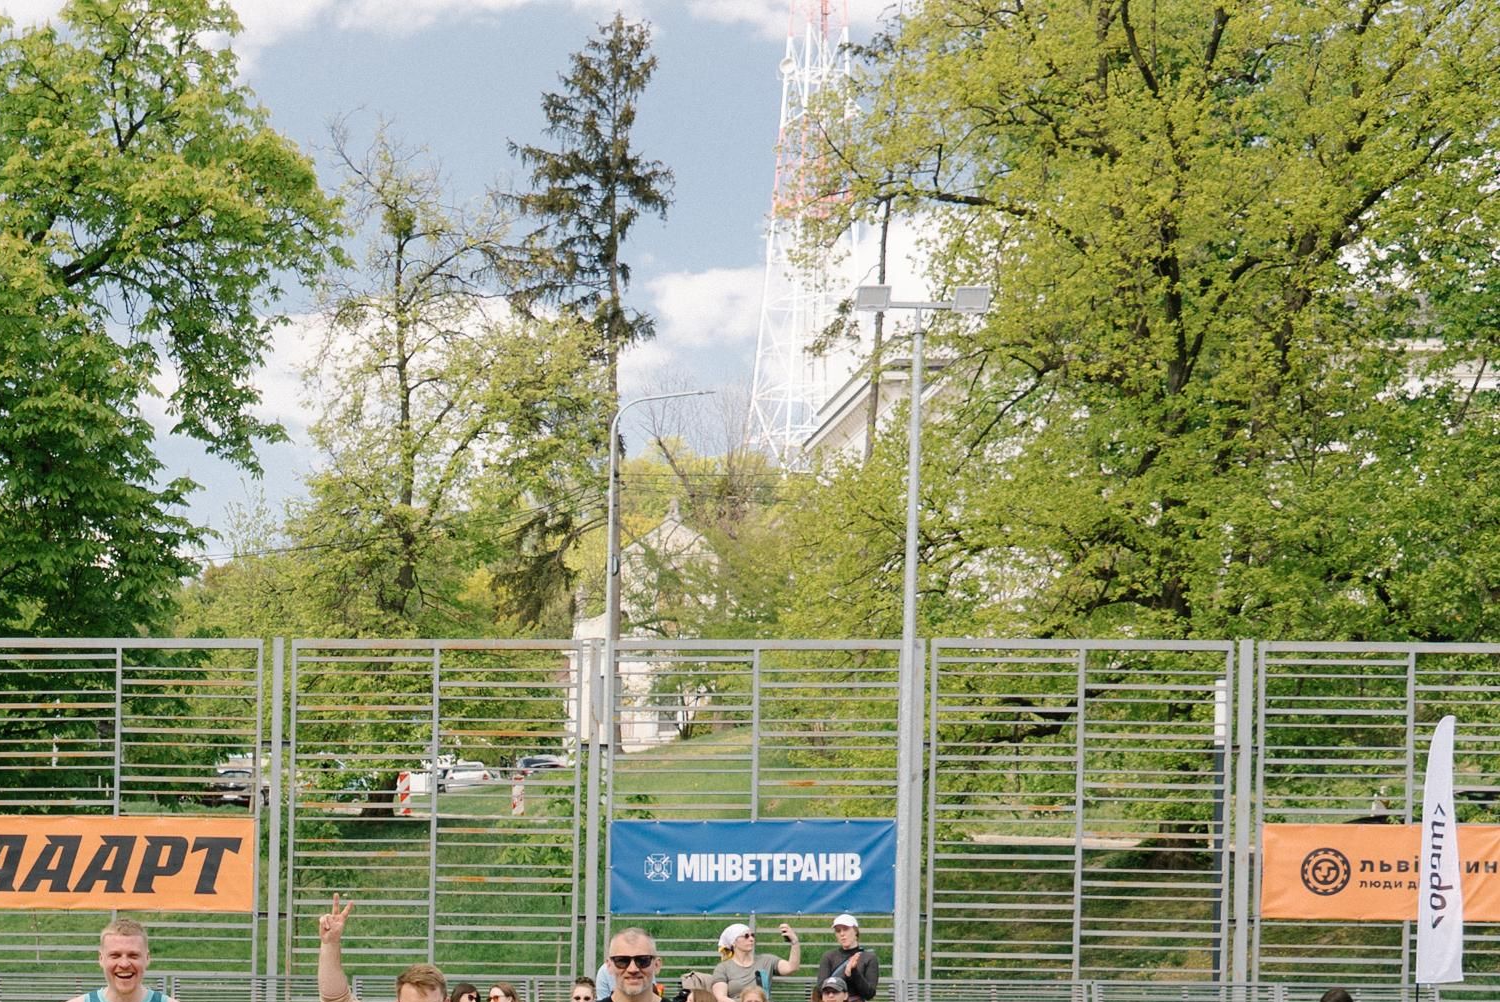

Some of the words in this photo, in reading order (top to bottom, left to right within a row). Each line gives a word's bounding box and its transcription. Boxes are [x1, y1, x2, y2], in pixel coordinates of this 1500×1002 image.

[677, 853, 862, 882] МІНВЕТЕРАНІВ
[1359, 856, 1498, 874] львіин
[1359, 880, 1403, 890] люди
